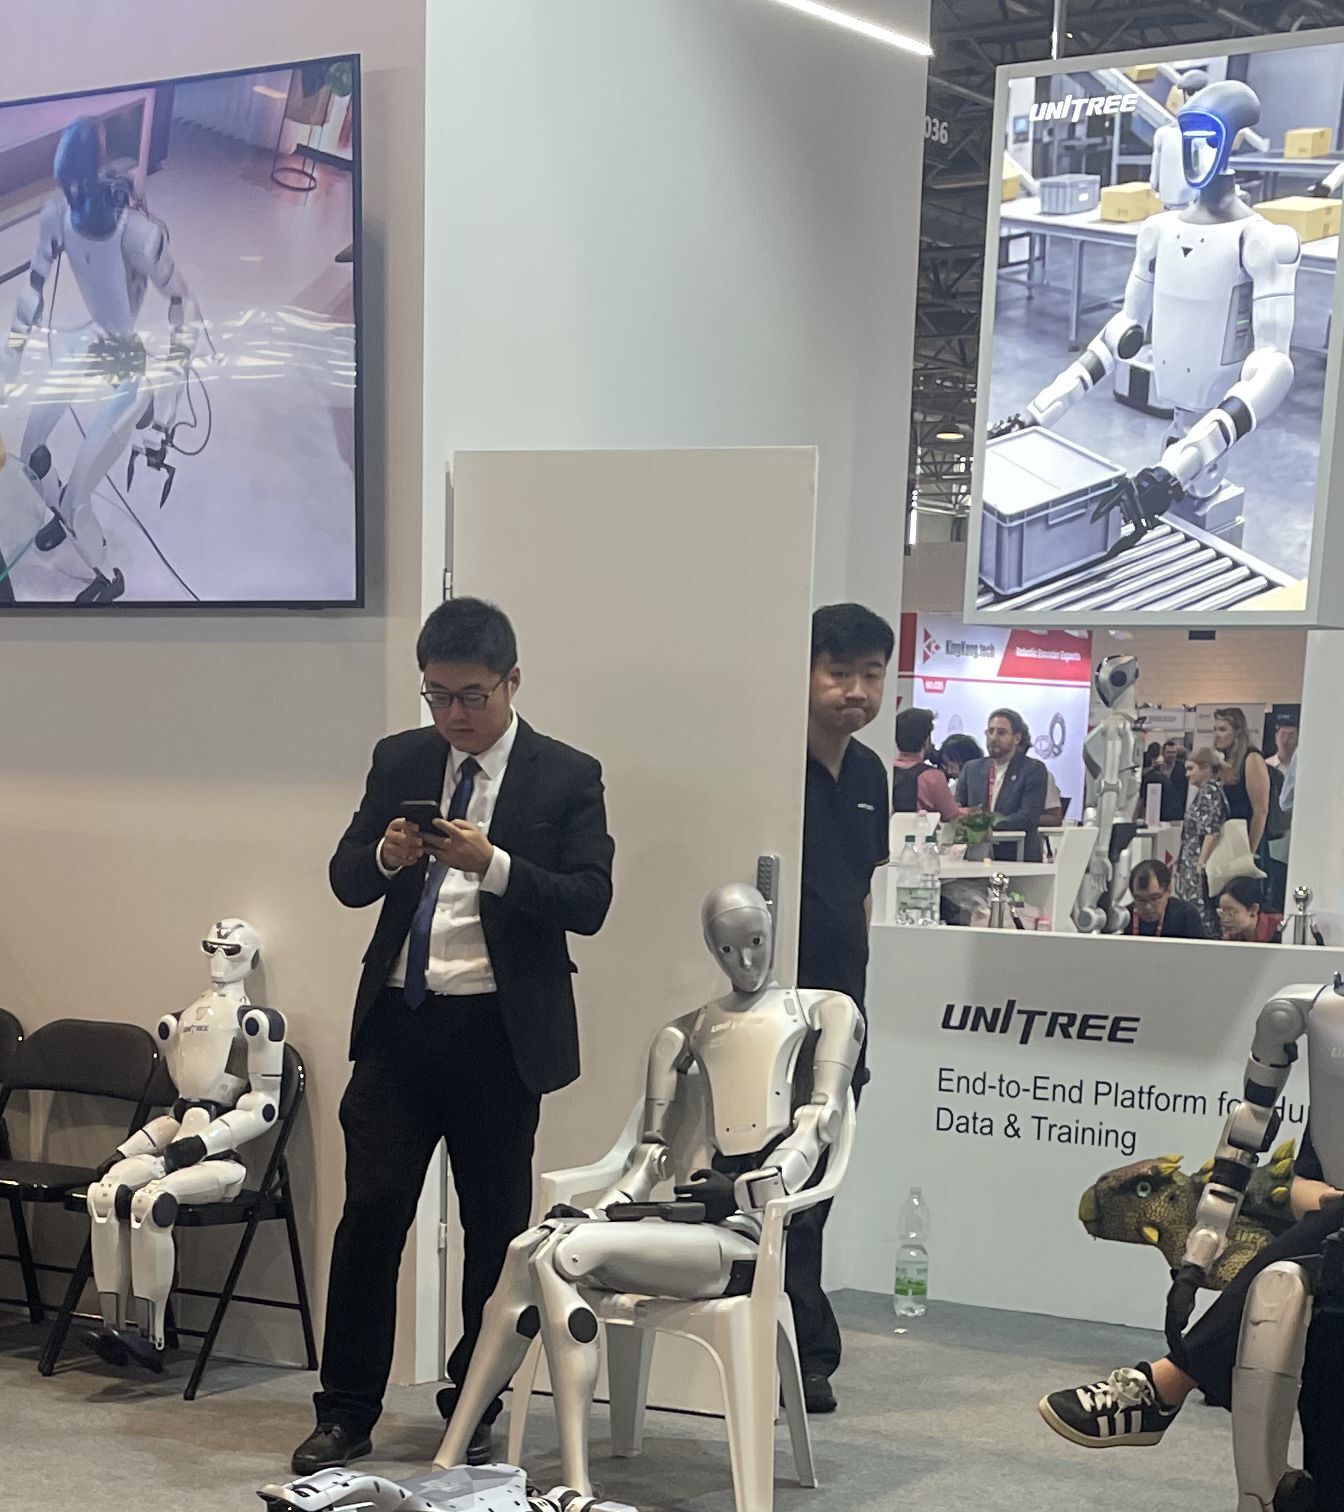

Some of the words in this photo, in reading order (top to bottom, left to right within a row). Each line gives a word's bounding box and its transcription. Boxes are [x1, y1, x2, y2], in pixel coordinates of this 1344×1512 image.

[1028, 93, 1139, 123] UNITREE
[941, 999, 1141, 1045] UNITREE
[938, 1067, 1084, 1105] End-to-End
[1094, 1080, 1208, 1116] Platform
[936, 1106, 994, 1137] Data
[1003, 1113, 1022, 1139] &
[1031, 1115, 1137, 1157] Training
